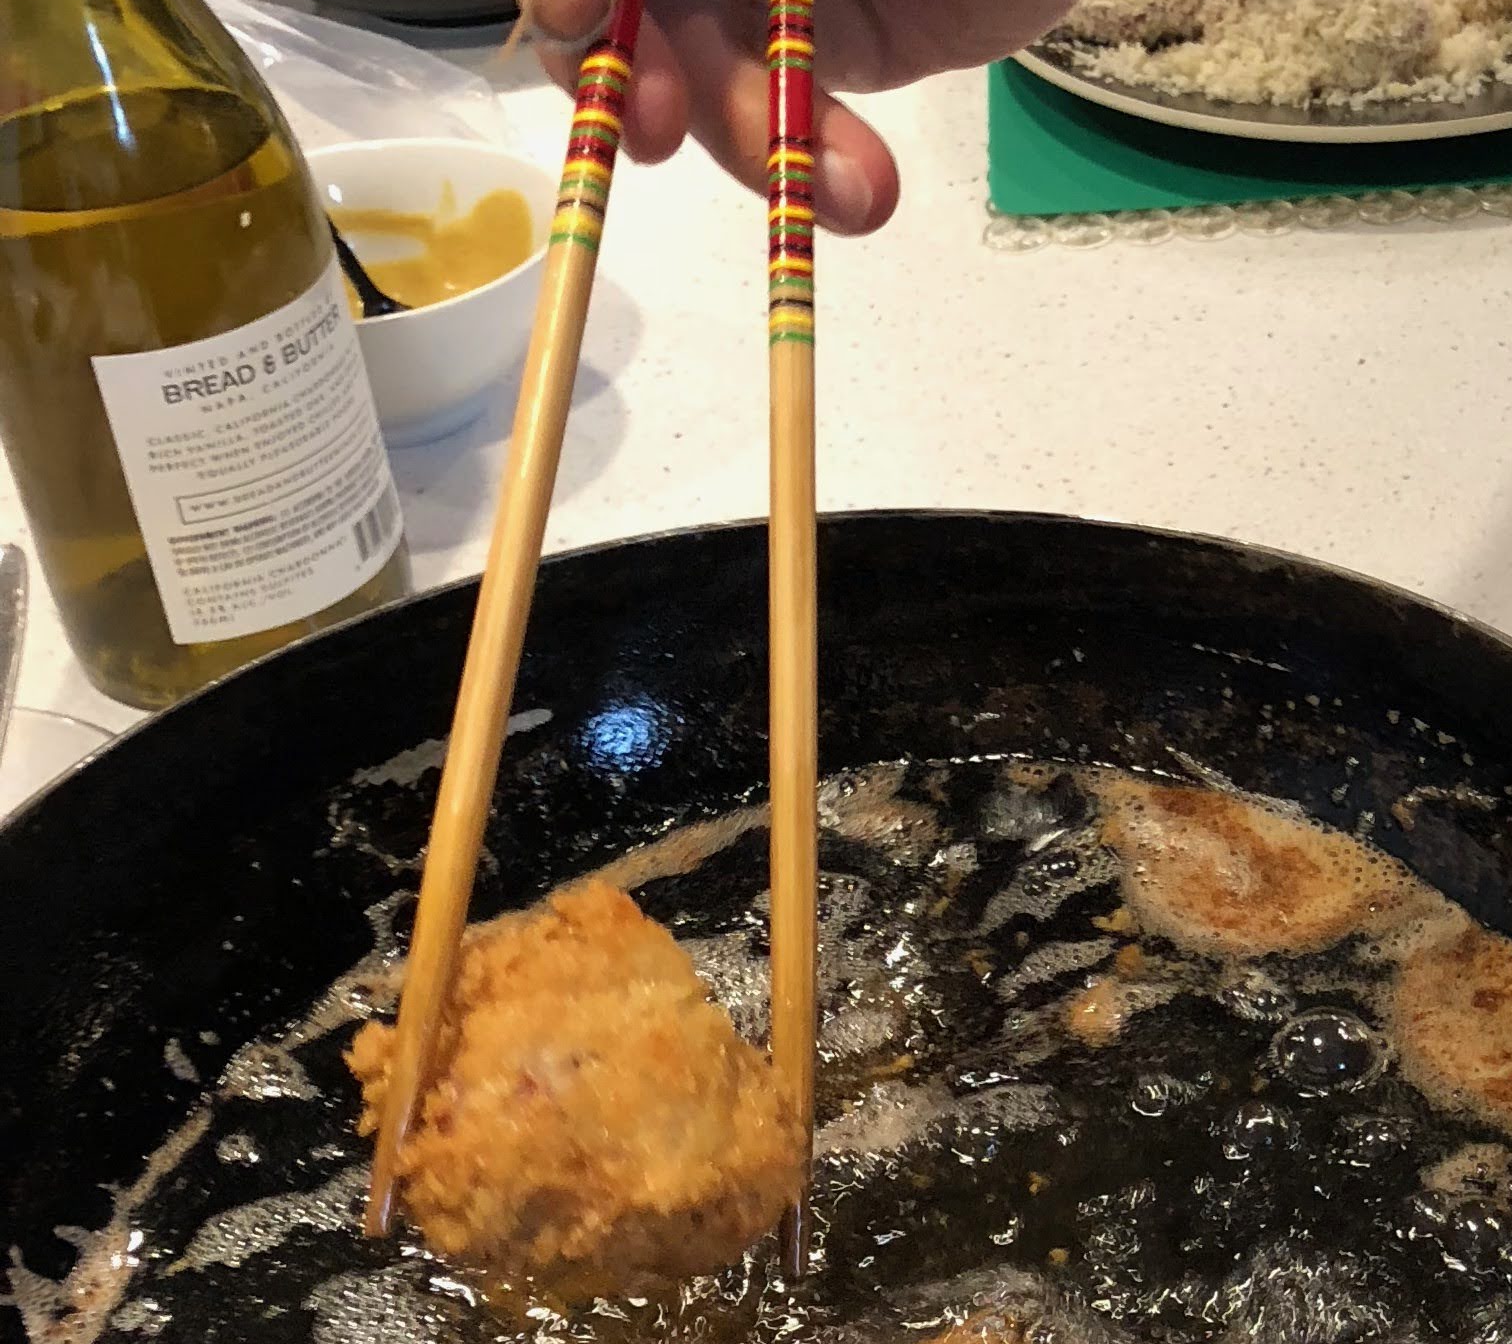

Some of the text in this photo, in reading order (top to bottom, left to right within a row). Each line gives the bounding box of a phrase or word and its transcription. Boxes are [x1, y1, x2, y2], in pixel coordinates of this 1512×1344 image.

[161, 303, 341, 406] BREAD & BUTTER
